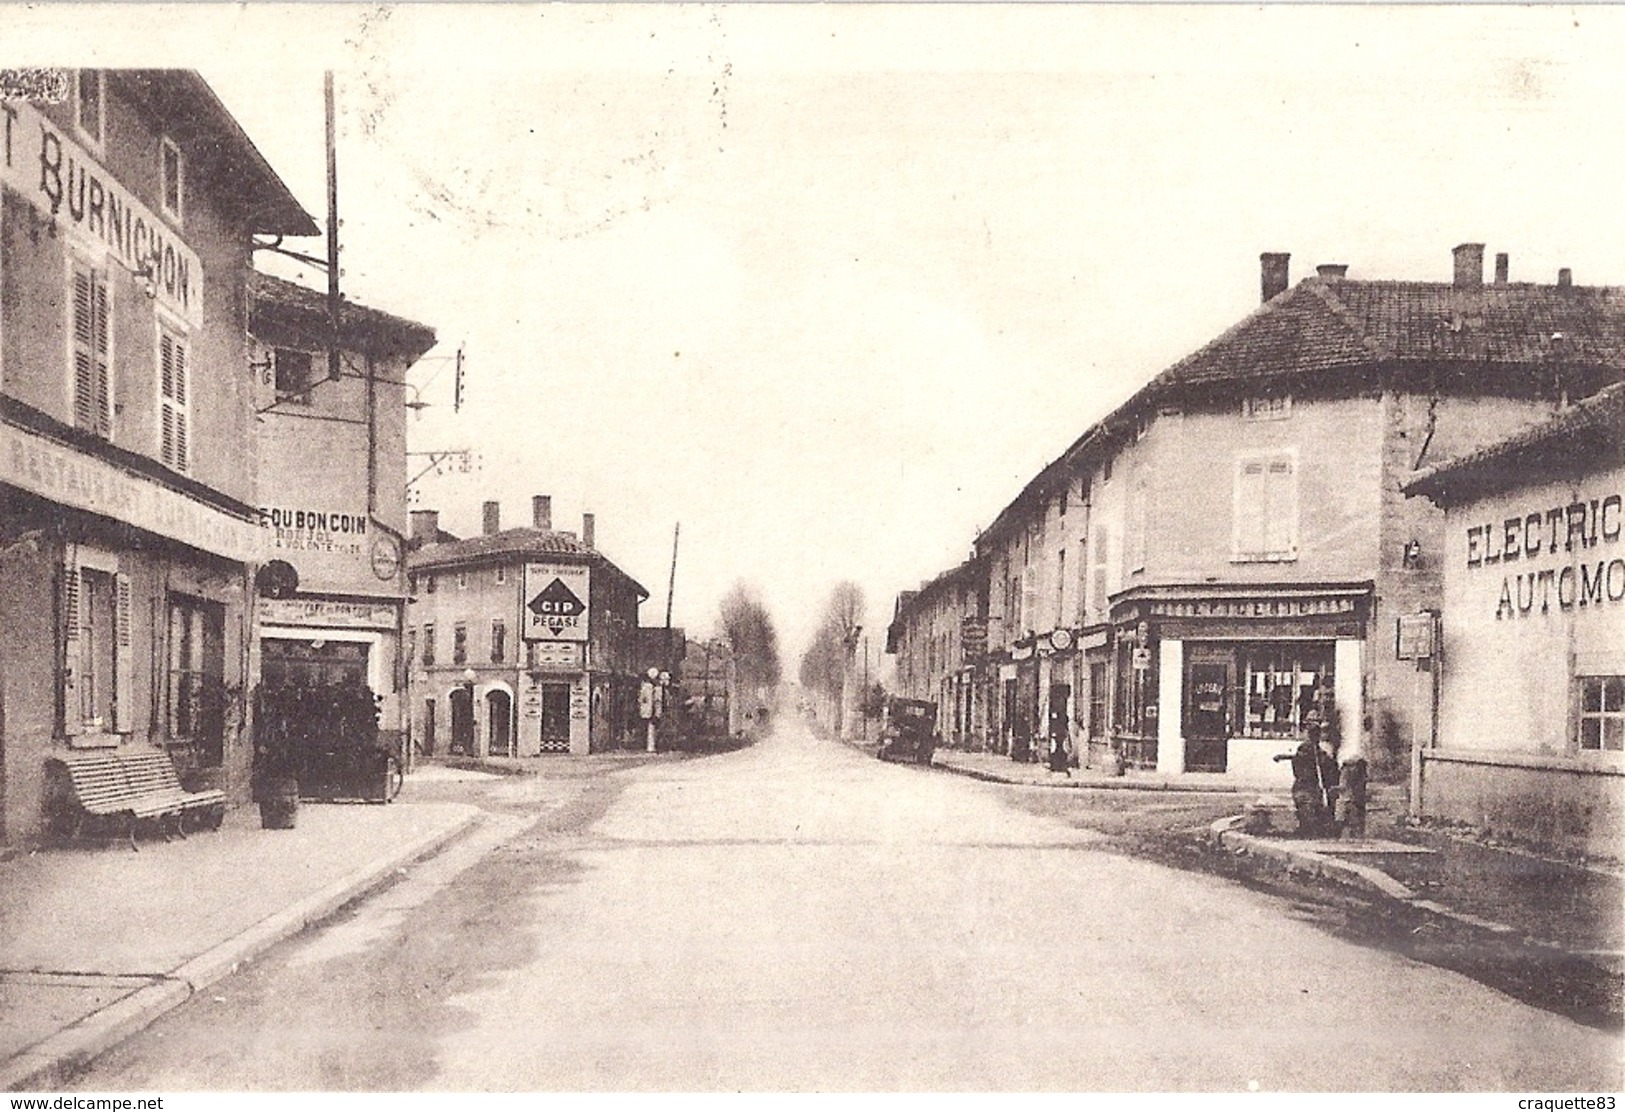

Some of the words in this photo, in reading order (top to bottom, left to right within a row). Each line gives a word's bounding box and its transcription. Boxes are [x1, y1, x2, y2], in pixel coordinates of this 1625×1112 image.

[40, 123, 190, 313] BURNICHON
[296, 510, 327, 531] BON
[330, 513, 366, 535] COIN
[1467, 495, 1621, 569] ELECTRIC
[541, 601, 574, 613] CIP
[1496, 558, 1625, 620] AUTOMO
[532, 616, 580, 628] PEGASE
